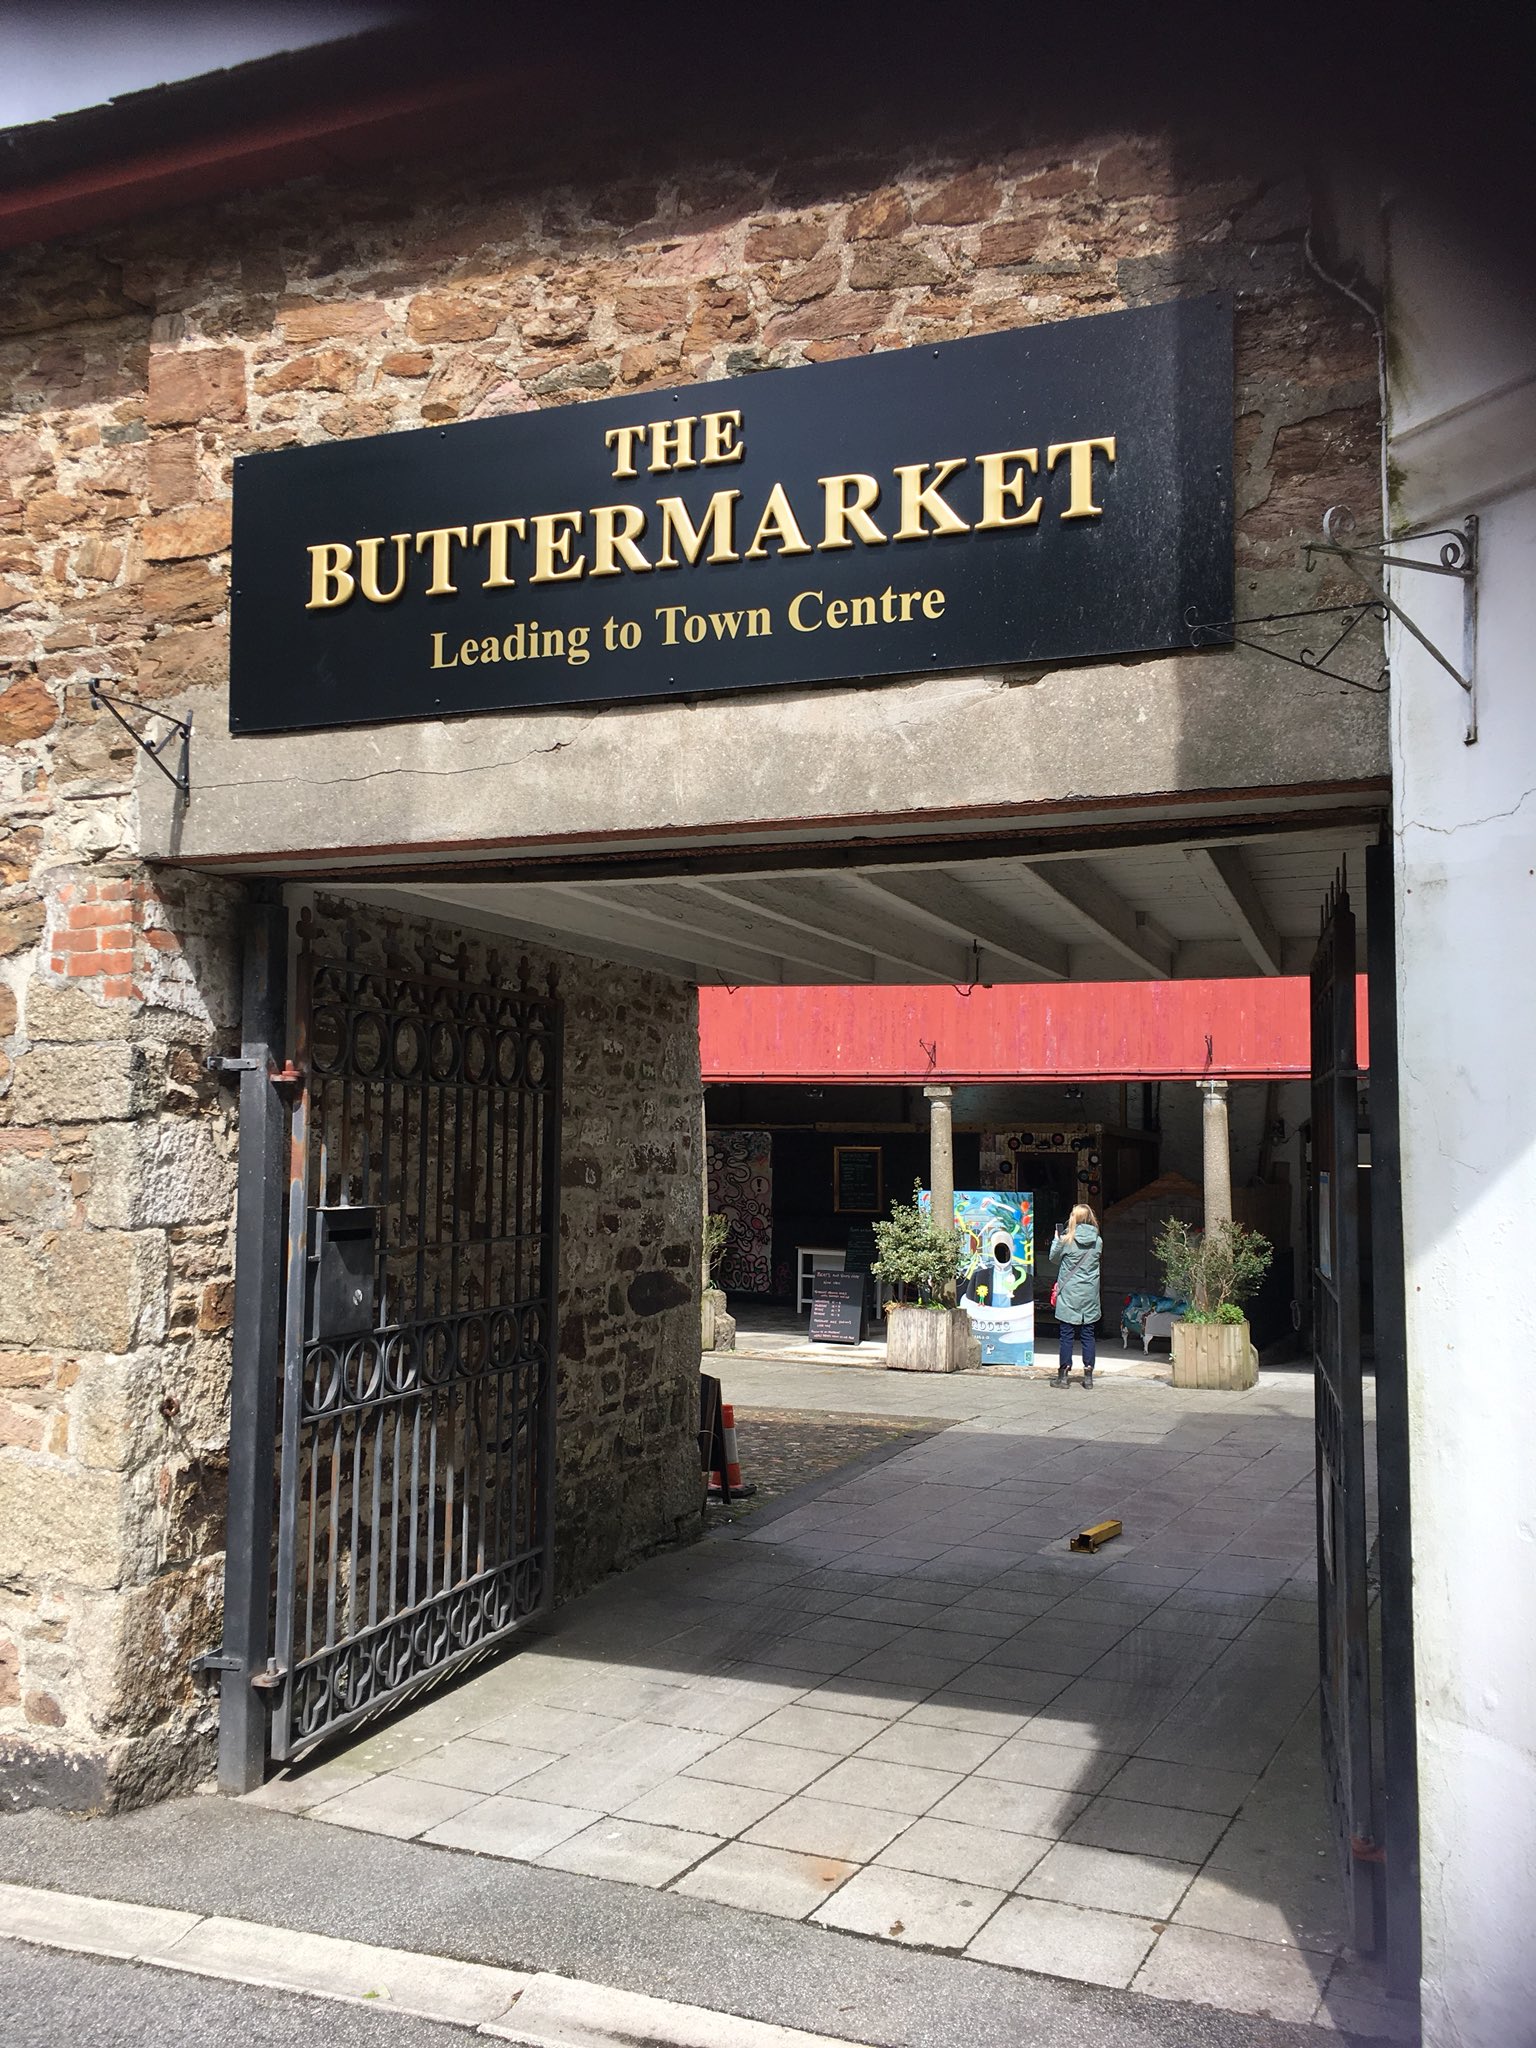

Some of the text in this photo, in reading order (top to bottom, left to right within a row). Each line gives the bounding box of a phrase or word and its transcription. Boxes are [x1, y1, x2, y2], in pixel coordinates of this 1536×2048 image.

[605, 409, 744, 477] THE
[304, 436, 1117, 609] BUTTERMARKET
[431, 586, 945, 669] Leading to Town Centre
